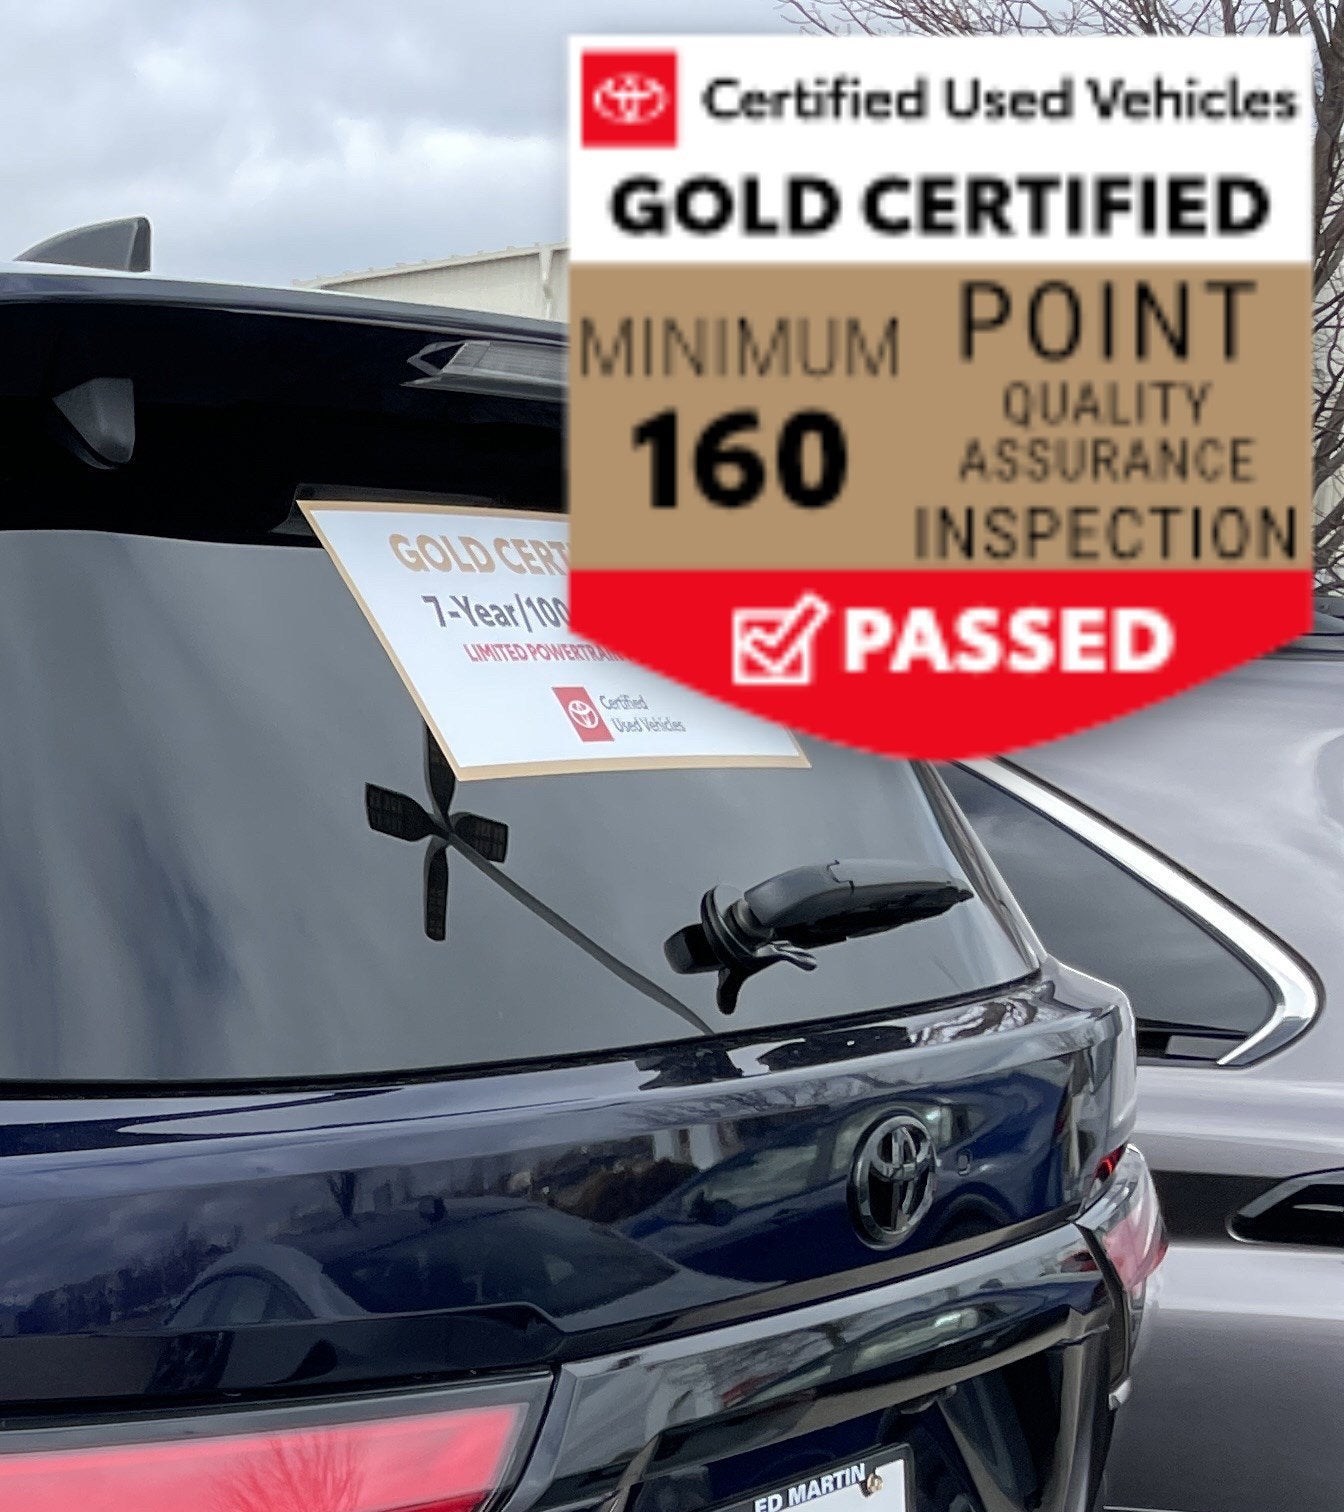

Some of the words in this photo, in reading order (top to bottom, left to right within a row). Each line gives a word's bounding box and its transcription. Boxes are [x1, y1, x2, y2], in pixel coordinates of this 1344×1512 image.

[388, 533, 496, 573] GOLD
[493, 537, 570, 576] CERT
[462, 643, 528, 662] LIMITED
[599, 694, 649, 710] Certified
[611, 716, 643, 732] Used
[638, 716, 687, 732] Vehicles
[788, 1463, 866, 1507] MARTIN
